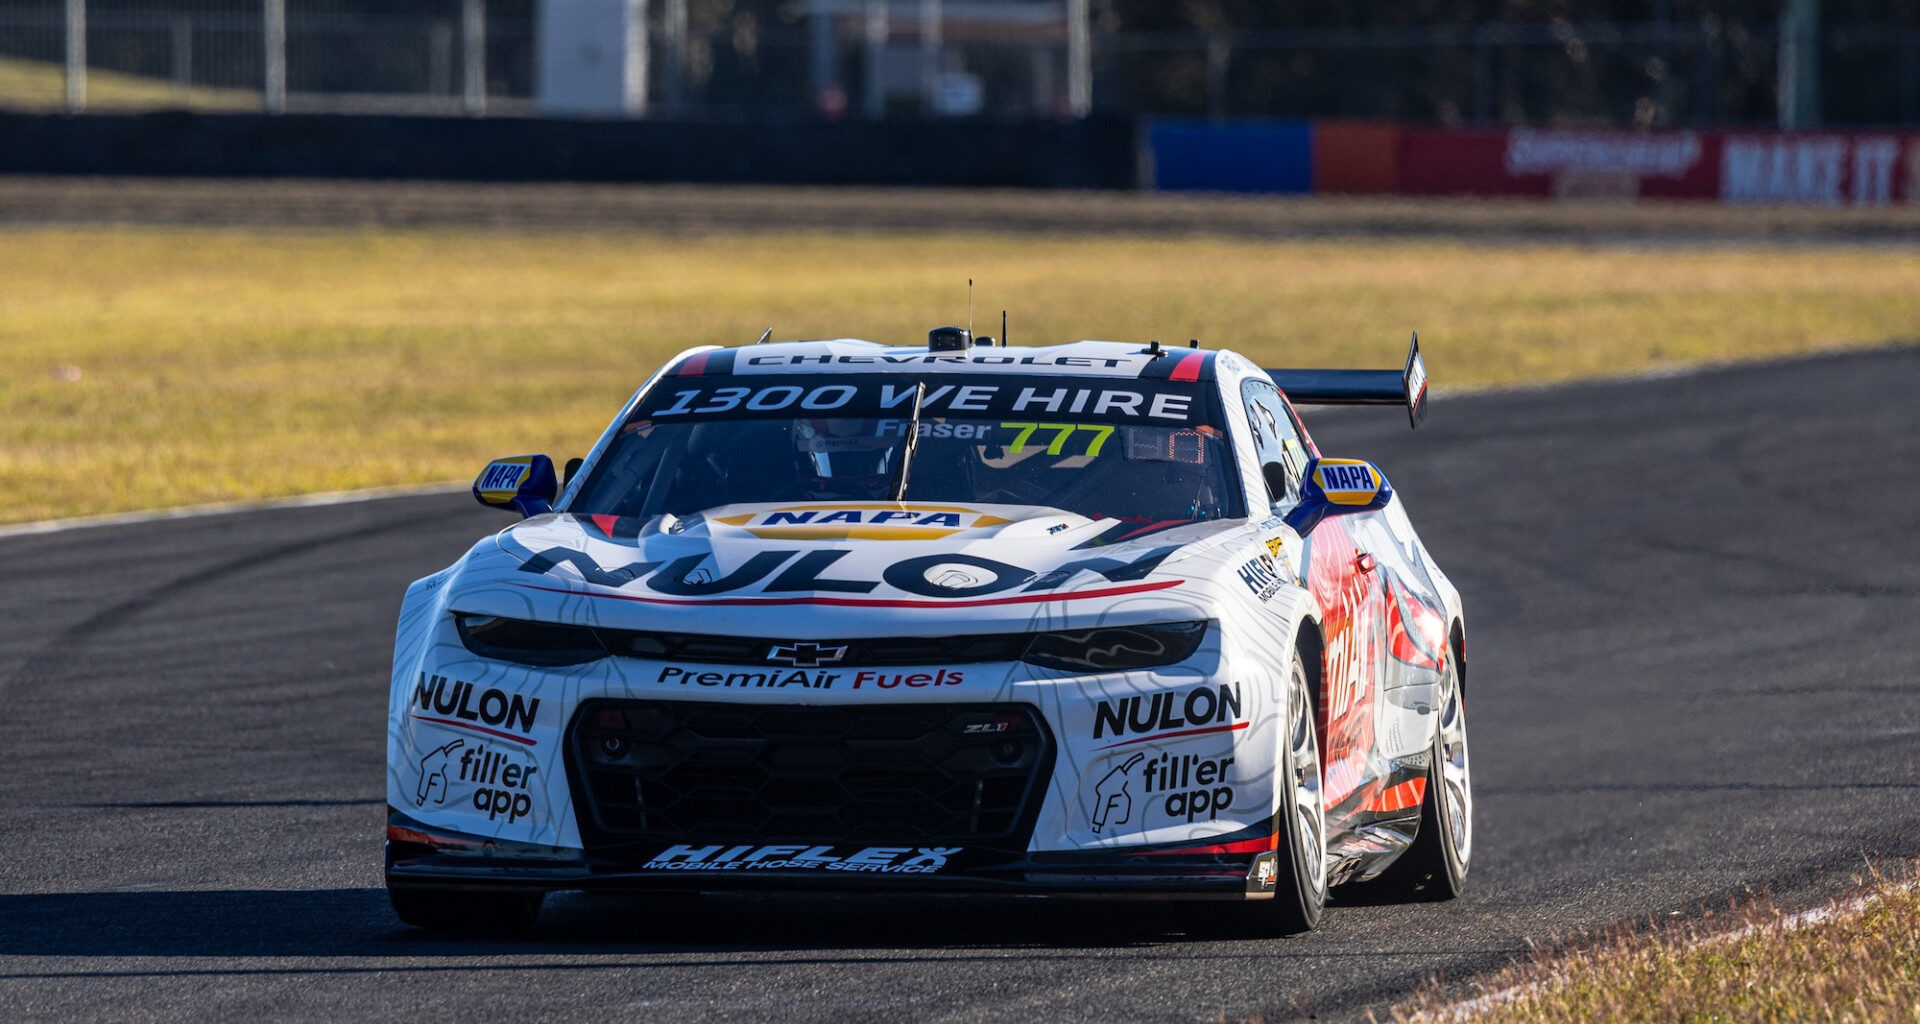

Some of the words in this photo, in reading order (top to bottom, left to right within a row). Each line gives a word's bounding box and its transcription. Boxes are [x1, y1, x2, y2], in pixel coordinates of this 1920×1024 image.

[748, 355, 1132, 368] CHEVROLET
[651, 385, 858, 416] 1300
[879, 385, 999, 410] WE
[1012, 387, 1192, 420] HIRE
[876, 419, 992, 439] Fraser
[1000, 422, 1115, 457] 777
[481, 464, 525, 488] NAPA
[1322, 465, 1375, 489] NAPA
[761, 511, 960, 527] NAPA
[517, 544, 1188, 598] NULON
[656, 667, 841, 689] PremiAir
[853, 669, 964, 689] Fuels
[413, 671, 541, 734] NULON
[1093, 682, 1241, 739] NULON
[473, 787, 531, 824] app
[1165, 786, 1233, 823] app
[642, 861, 738, 870] MOBILE
[750, 860, 823, 869] HOSE
[825, 862, 942, 873] SERVICE
[653, 845, 963, 866] HIFLEX
